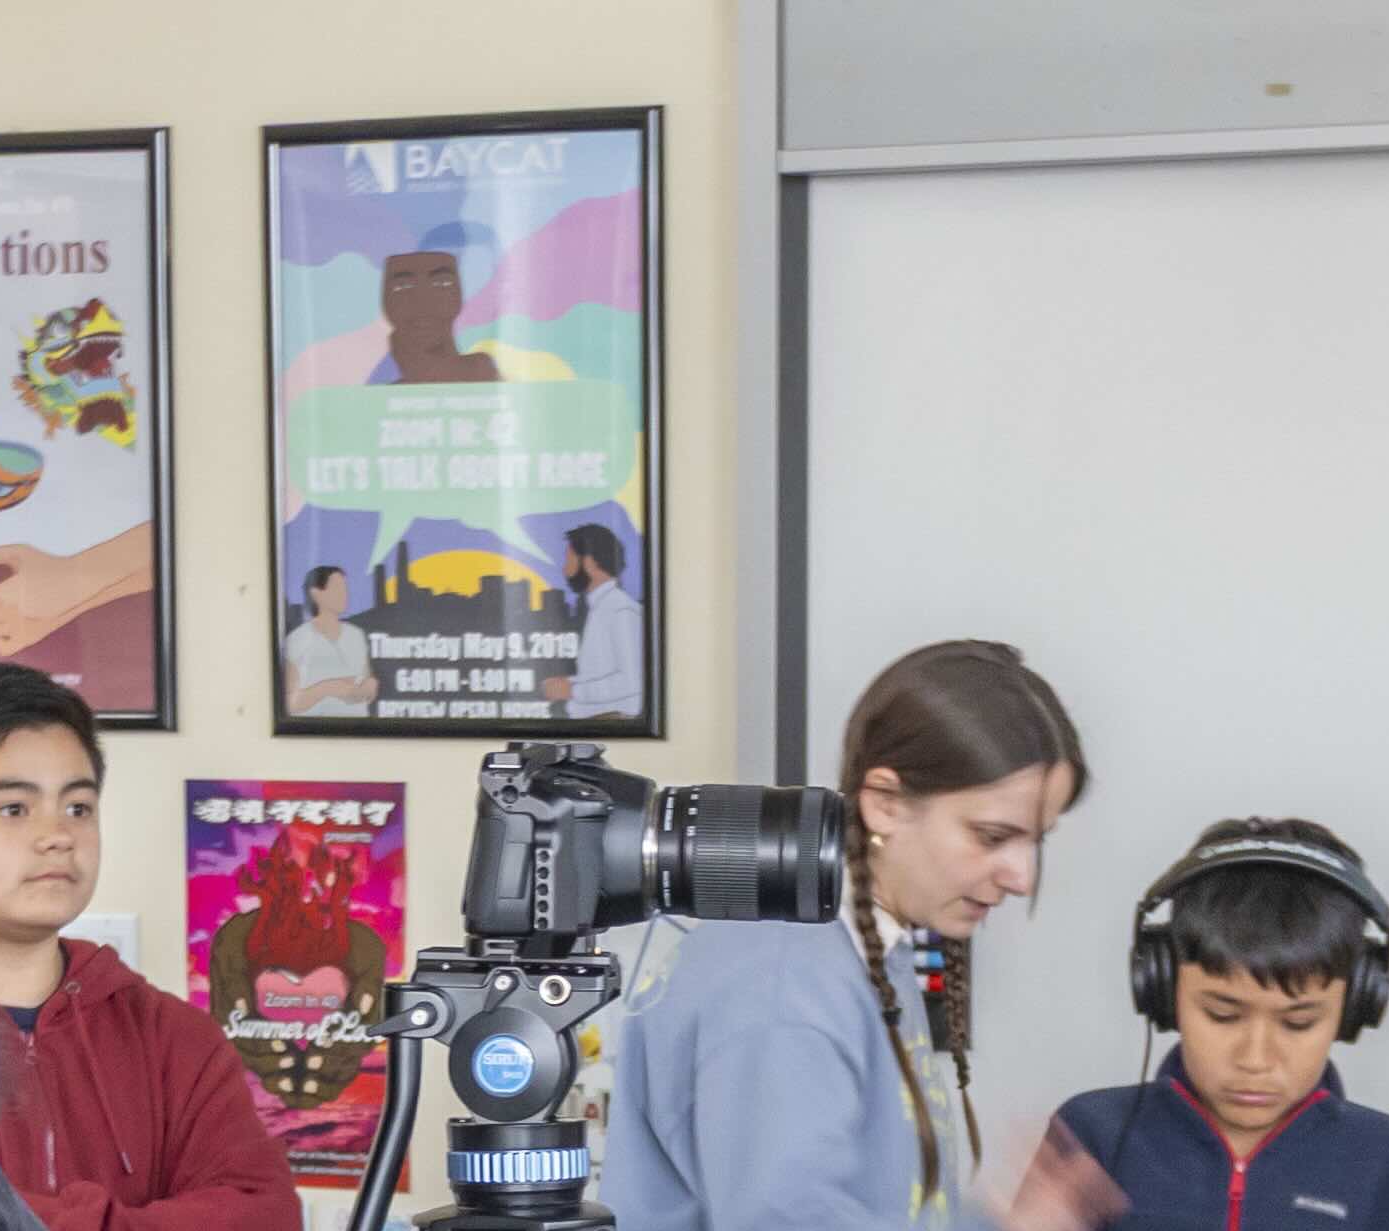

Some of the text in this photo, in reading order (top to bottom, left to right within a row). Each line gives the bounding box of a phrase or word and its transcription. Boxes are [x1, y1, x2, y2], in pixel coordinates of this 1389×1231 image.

[406, 138, 569, 179] BAYCAT
[306, 451, 610, 492] LET'S TALK ABOUT RACE
[368, 632, 461, 661] Thursday
[463, 632, 506, 661] May
[529, 632, 579, 659] 2019
[395, 668, 432, 693] 6:00
[434, 669, 460, 692] PM
[507, 668, 536, 693] PM
[264, 991, 302, 1007] Zoom
[222, 1009, 307, 1040] Summer
